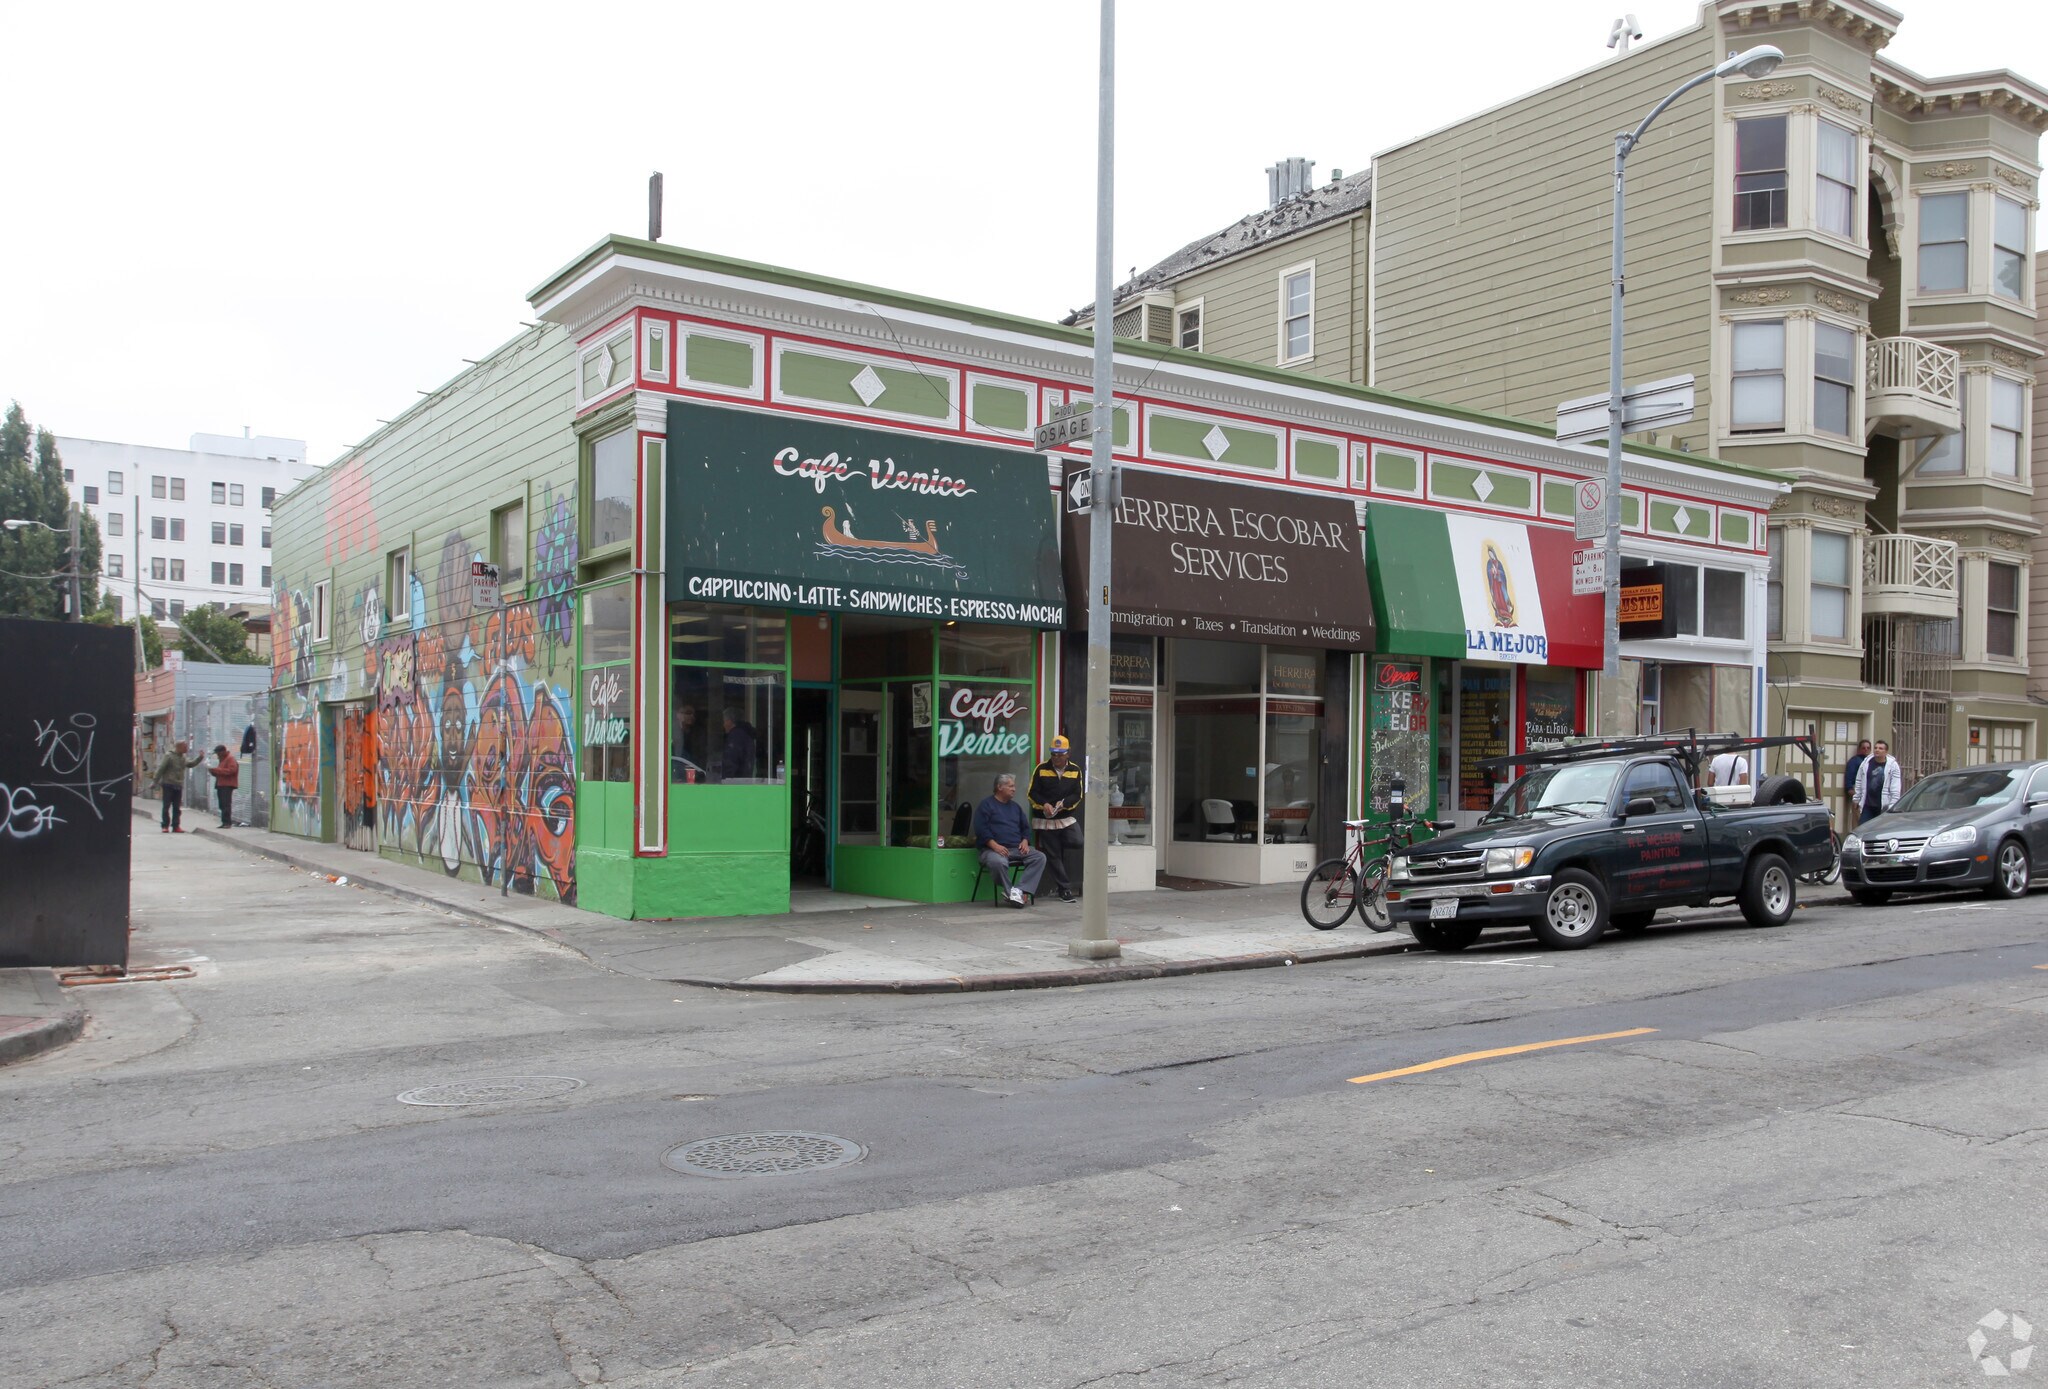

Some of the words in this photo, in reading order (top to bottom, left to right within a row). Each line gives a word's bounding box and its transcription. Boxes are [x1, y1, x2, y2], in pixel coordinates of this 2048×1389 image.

[1040, 418, 1088, 443] OSAGE
[773, 446, 867, 494] Café
[868, 457, 977, 498] Venice
[1081, 482, 1091, 497] ON
[1229, 507, 1350, 553] ESCOBAR
[1171, 542, 1288, 583] SERVICES
[1573, 553, 1583, 564] NO
[1584, 552, 1605, 562] PARKING
[474, 578, 498, 588] PARKING
[689, 576, 792, 602] CAPPUCCINO
[799, 585, 842, 607] LATTE
[850, 589, 943, 615] SANDWICHES
[951, 597, 1016, 620] ESPRESSO
[1019, 604, 1063, 625] MOCHA
[1620, 595, 1659, 612] USTIC
[1110, 611, 1174, 628] mmigration
[1193, 617, 1224, 632] Taxes
[1240, 620, 1296, 637] Translation
[1311, 626, 1361, 642] Weddings
[1466, 630, 1488, 650] LA
[1489, 631, 1548, 660] MEJOR
[1499, 653, 1518, 661] BAKERY
[1110, 655, 1151, 669] ERRERA
[1273, 665, 1316, 680] HERRERA
[1380, 664, 1419, 687] Open
[590, 673, 623, 719] Café
[949, 688, 1028, 734] Café
[584, 708, 628, 747] Venice
[938, 719, 1032, 757] Venice
[1525, 721, 1544, 734] PARA
[1641, 846, 1680, 861] PAINTING
